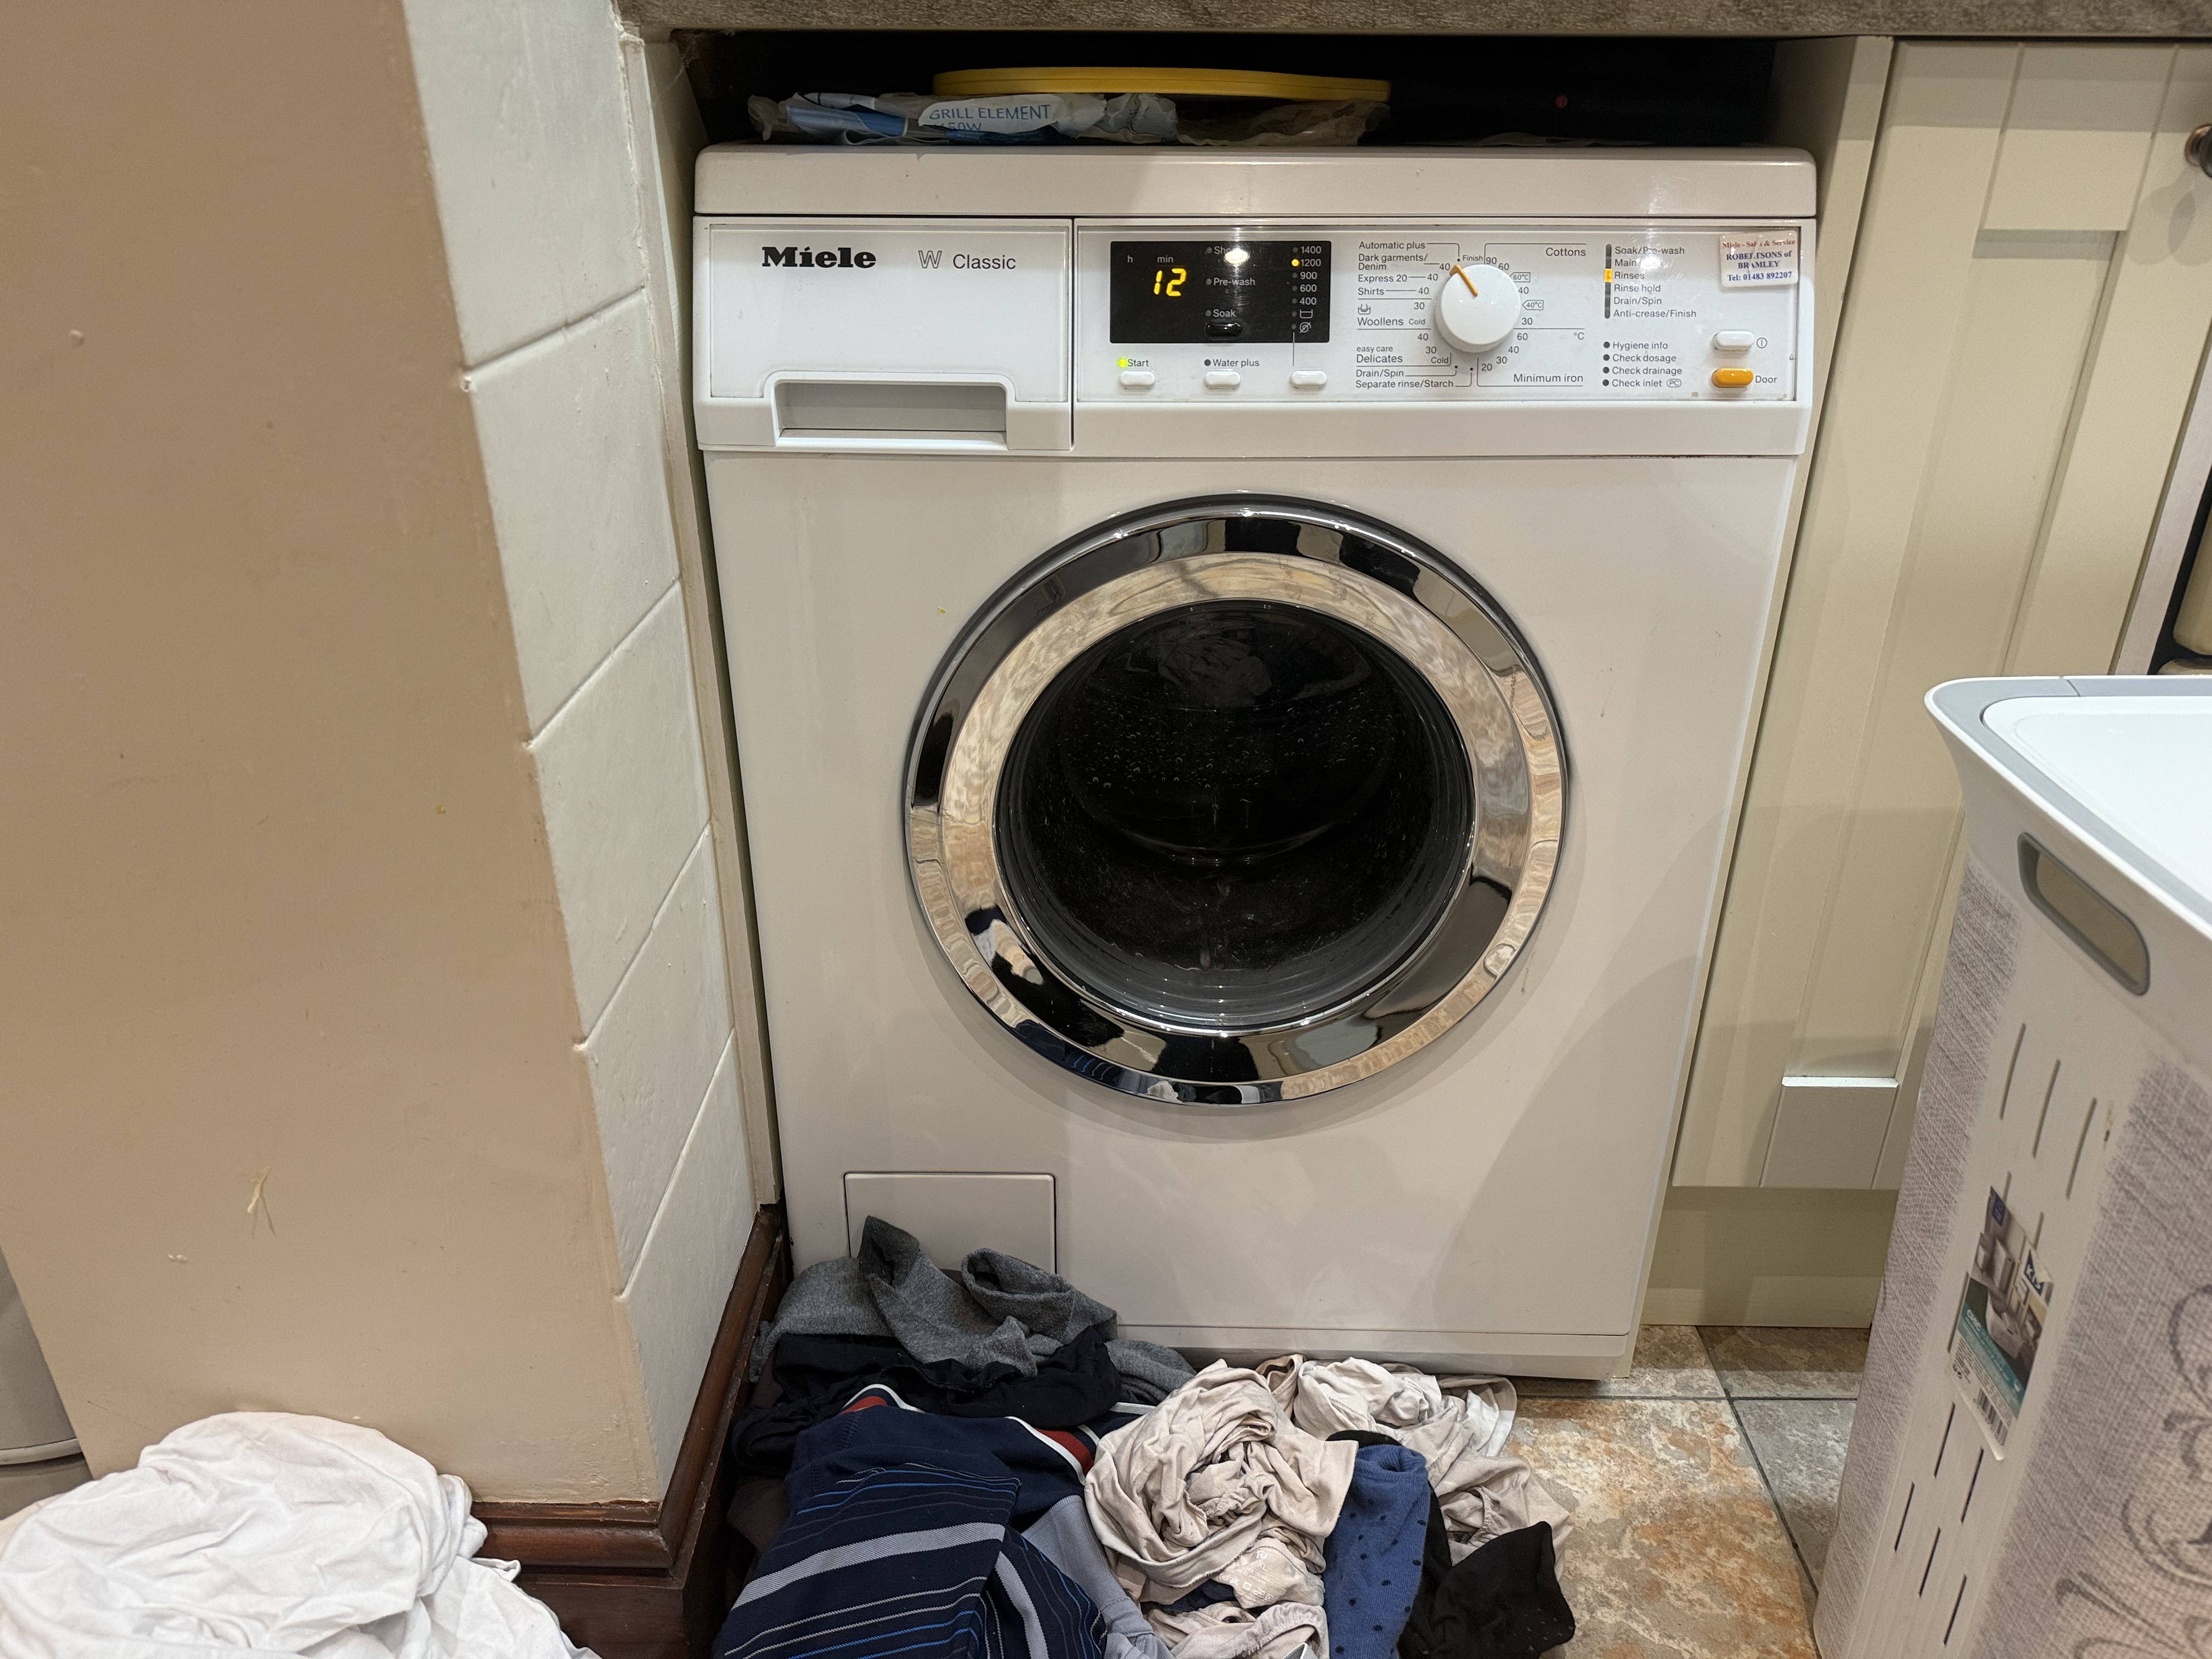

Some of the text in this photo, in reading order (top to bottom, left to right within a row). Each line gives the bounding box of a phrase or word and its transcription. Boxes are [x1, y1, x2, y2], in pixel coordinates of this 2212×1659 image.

[929, 104, 1051, 120] GRILL ELEMENT
[1300, 246, 1322, 255] 1400
[1358, 241, 1426, 251] Automatic plus
[1545, 247, 1587, 257] Cottons
[761, 246, 877, 269] Miele
[918, 250, 1017, 270] W Classic
[1127, 255, 1133, 263] h
[1157, 255, 1173, 263] min
[1358, 253, 1428, 263] Dark garments/
[1300, 258, 1322, 267] 1200
[1300, 272, 1317, 280] 900
[1358, 274, 1393, 284] Express
[1615, 271, 1645, 279] Rinses
[1153, 268, 1187, 297] 12
[1214, 278, 1256, 286] Pre-wash
[1300, 284, 1317, 293] 600
[1357, 287, 1385, 295] Shirts
[1641, 284, 1661, 292] hold
[1299, 297, 1317, 305] 400
[1613, 296, 1662, 306] Drain/Spin
[1413, 302, 1425, 310] 30
[1213, 308, 1236, 317] Soak
[1613, 309, 1697, 318] Anti-crease/Finish
[1357, 317, 1404, 326] Woollens
[1521, 317, 1533, 325] 30
[1517, 332, 1528, 341] 60
[1573, 332, 1585, 341] °C
[1508, 346, 1519, 354] 40
[1612, 341, 1668, 351] Hygiene info
[1127, 358, 1149, 367] Start
[1356, 354, 1403, 363] Delicates
[1612, 354, 1677, 364] Check dosage
[1213, 359, 1260, 369] Water plus
[1481, 363, 1492, 371] 20
[1356, 369, 1404, 379] Drain/Spin
[1612, 366, 1683, 376] Check drainage
[1513, 373, 1583, 382] Minimum iron
[1755, 375, 1778, 383] Door
[1356, 380, 1454, 390] Separate rinse/Starch
[1612, 379, 1640, 387] Check
[1643, 379, 1662, 387] inlet
[1256, 1560, 1267, 1572] XL
